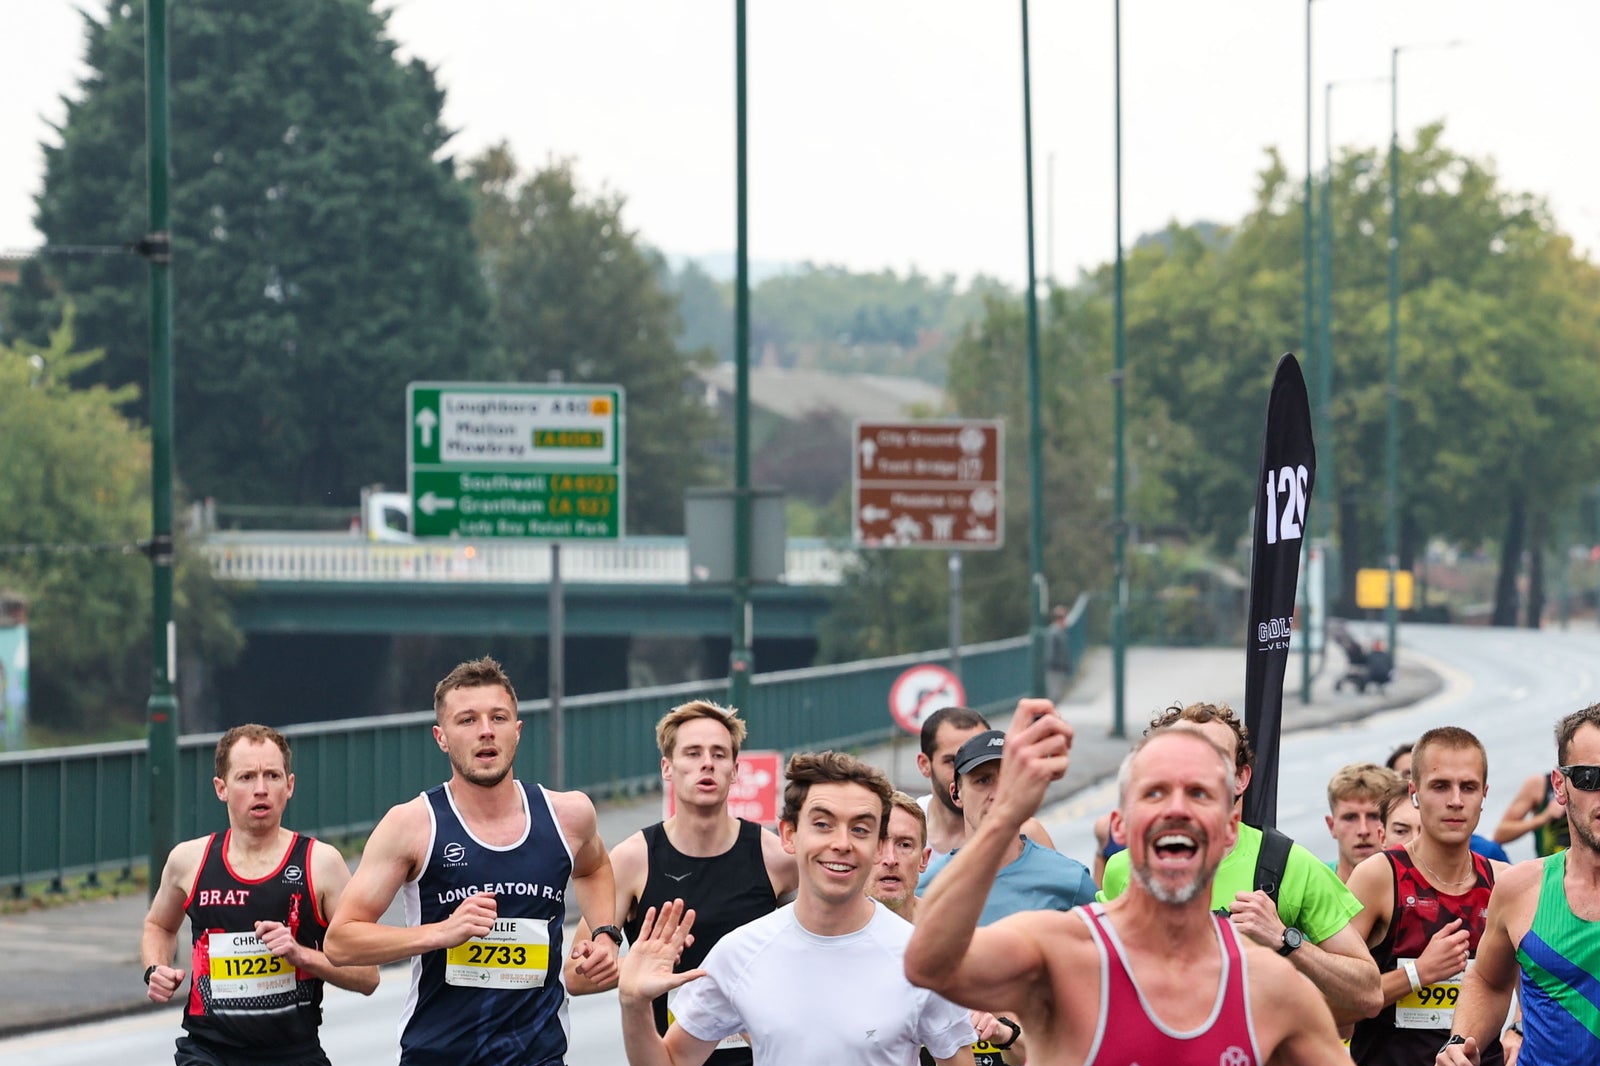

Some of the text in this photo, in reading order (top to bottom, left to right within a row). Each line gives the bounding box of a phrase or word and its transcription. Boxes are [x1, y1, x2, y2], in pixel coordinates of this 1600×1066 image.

[199, 889, 249, 906] BRAT
[438, 885, 479, 904] LONG
[484, 882, 538, 897] EATON
[491, 922, 516, 932] LLIE
[468, 945, 527, 965] 2733
[225, 956, 281, 976] 11225
